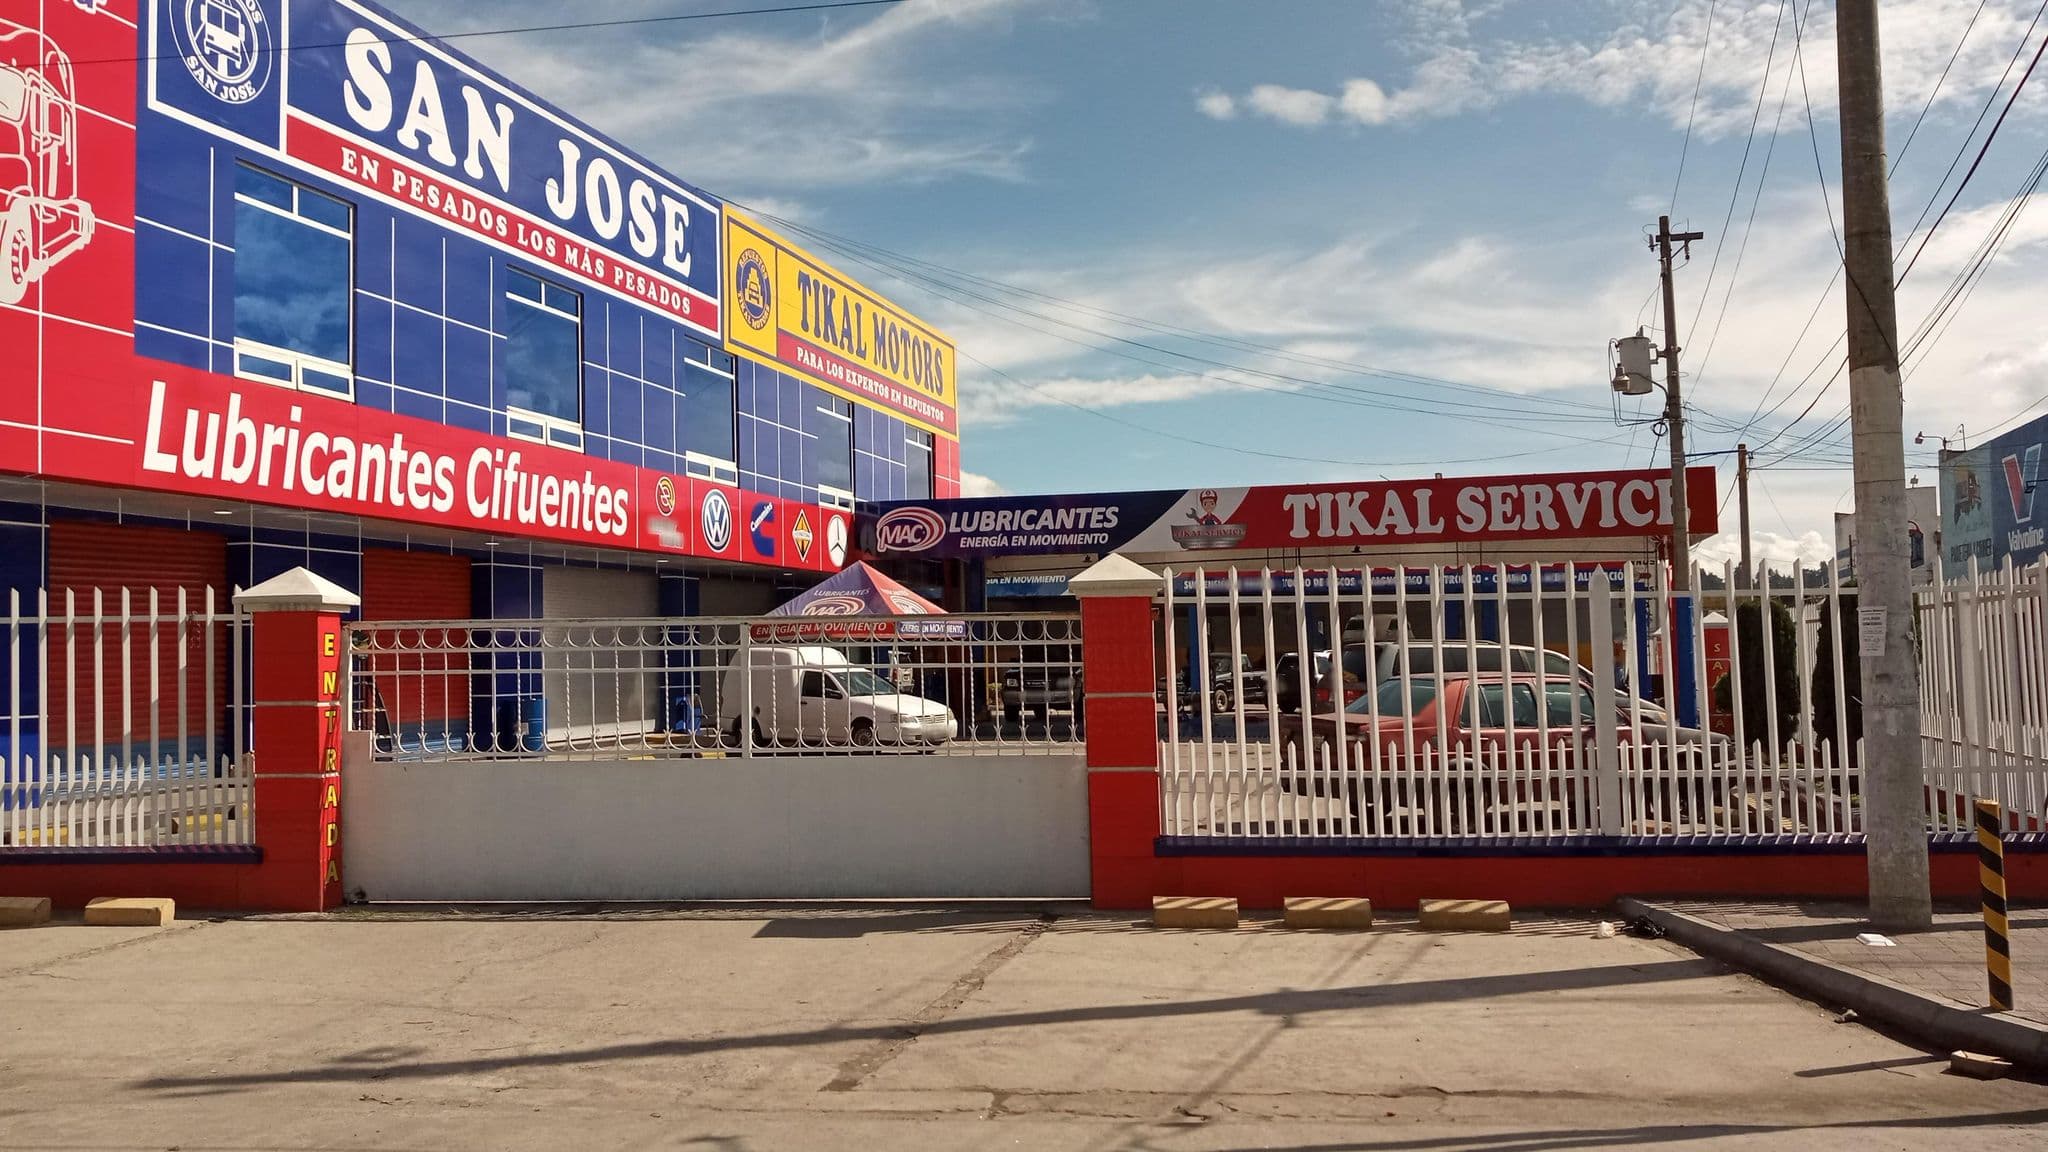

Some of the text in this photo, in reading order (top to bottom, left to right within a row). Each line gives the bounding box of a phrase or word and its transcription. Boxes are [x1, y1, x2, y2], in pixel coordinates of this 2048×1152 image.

[187, 55, 256, 101] SAN JOSE
[343, 27, 692, 278] SAN JOSE
[341, 147, 691, 315] EN PESADOS LOS MÁS PESADOS
[798, 270, 943, 396] TIKAL MOTORS
[796, 346, 944, 422] PARA LOS EXPERTOS EN REPUESTOS
[142, 380, 629, 536] Lubricantes Cifuentes
[878, 524, 925, 551] MAC
[950, 507, 1119, 533] LUBRICANTES
[1283, 488, 1445, 538] TIKAL
[960, 532, 1109, 548] ENERGÍA EN MOVIMIENTO
[2008, 527, 2045, 552] Valvoline
[1012, 574, 1067, 584] MOVIMIENTO
[322, 633, 340, 884] ENTRADA
